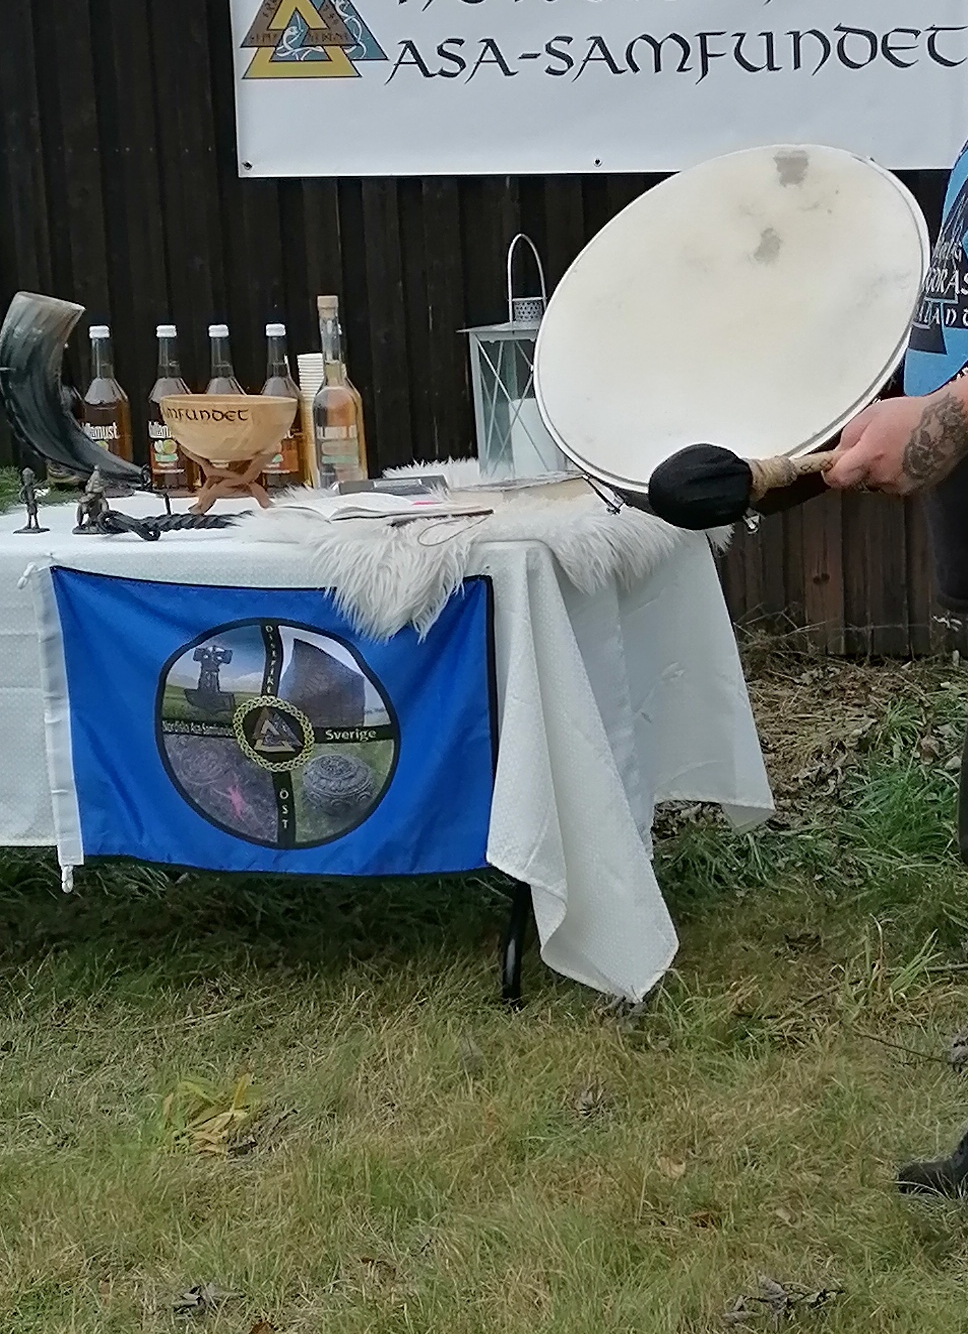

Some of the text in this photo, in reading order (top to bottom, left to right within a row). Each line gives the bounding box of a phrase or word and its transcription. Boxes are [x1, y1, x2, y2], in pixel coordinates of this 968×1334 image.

[385, 22, 968, 84] ASA-SAMFUNDET
[325, 728, 377, 742] Sverige
[279, 786, 290, 829] ÖST
